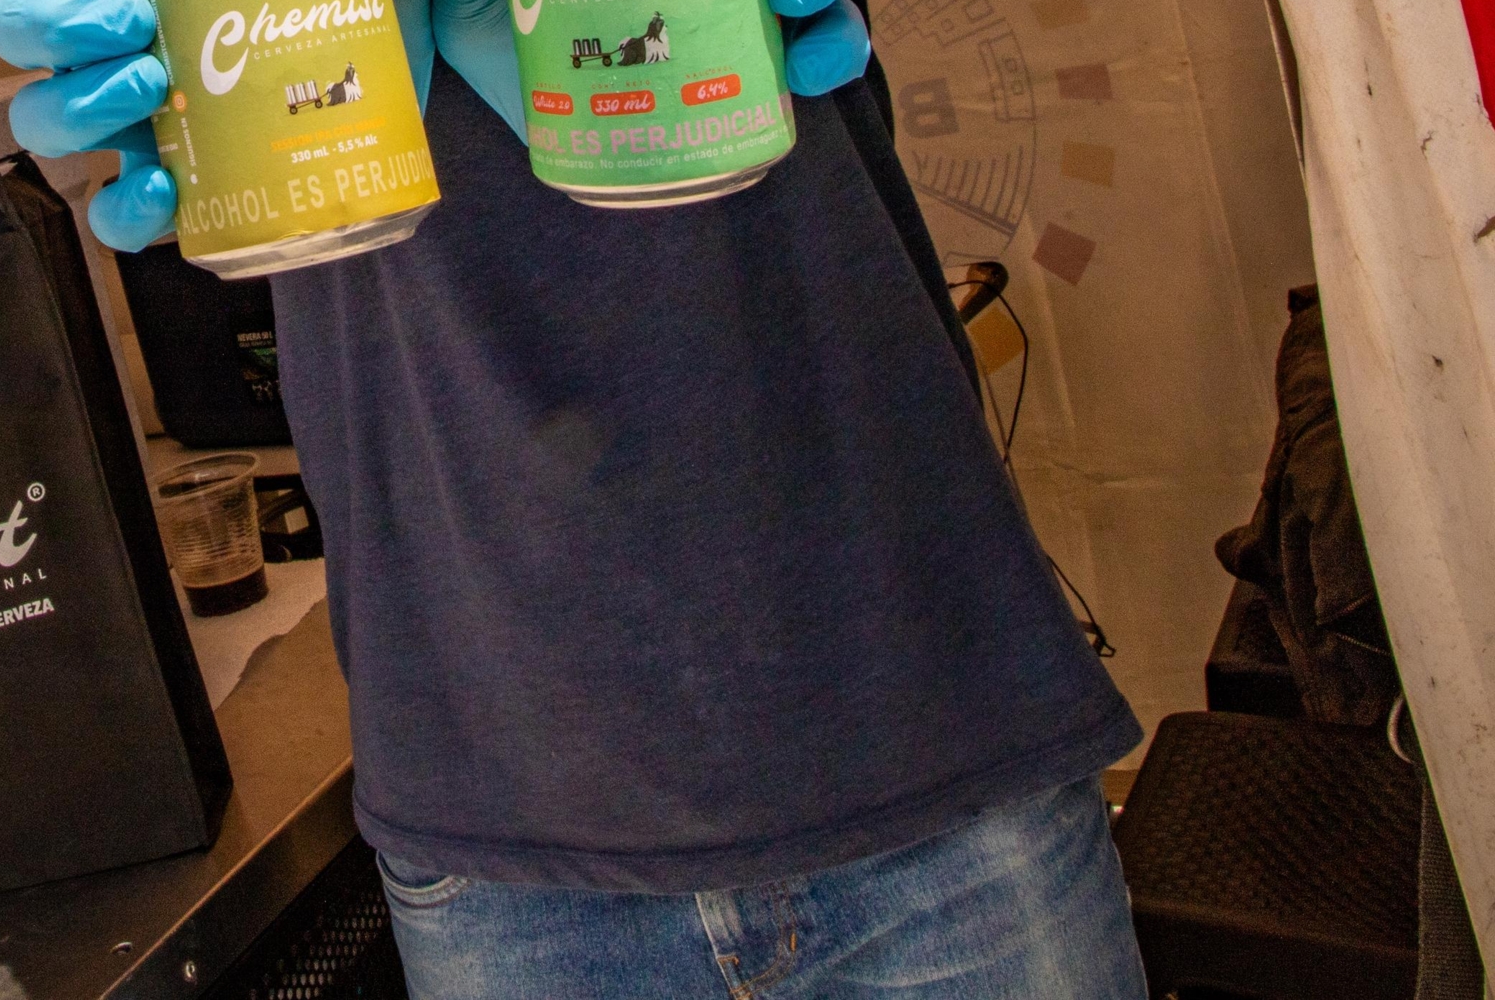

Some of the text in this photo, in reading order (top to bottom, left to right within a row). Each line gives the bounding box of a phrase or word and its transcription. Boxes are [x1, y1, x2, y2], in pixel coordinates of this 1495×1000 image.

[253, 24, 391, 60] CERVEZA ARTESANAL
[595, 99, 620, 113] 330
[570, 129, 602, 156] ES
[610, 101, 777, 155] PERJUDICIAL
[291, 149, 311, 164] 330
[313, 146, 329, 158] mL
[355, 137, 364, 148] %
[365, 133, 378, 146] Alc
[600, 158, 614, 169] No
[618, 156, 663, 169] conducir
[667, 154, 680, 165] en
[683, 148, 719, 162] estado
[722, 144, 734, 154] de
[181, 187, 279, 236] ALCOHOL
[287, 175, 325, 214] ES
